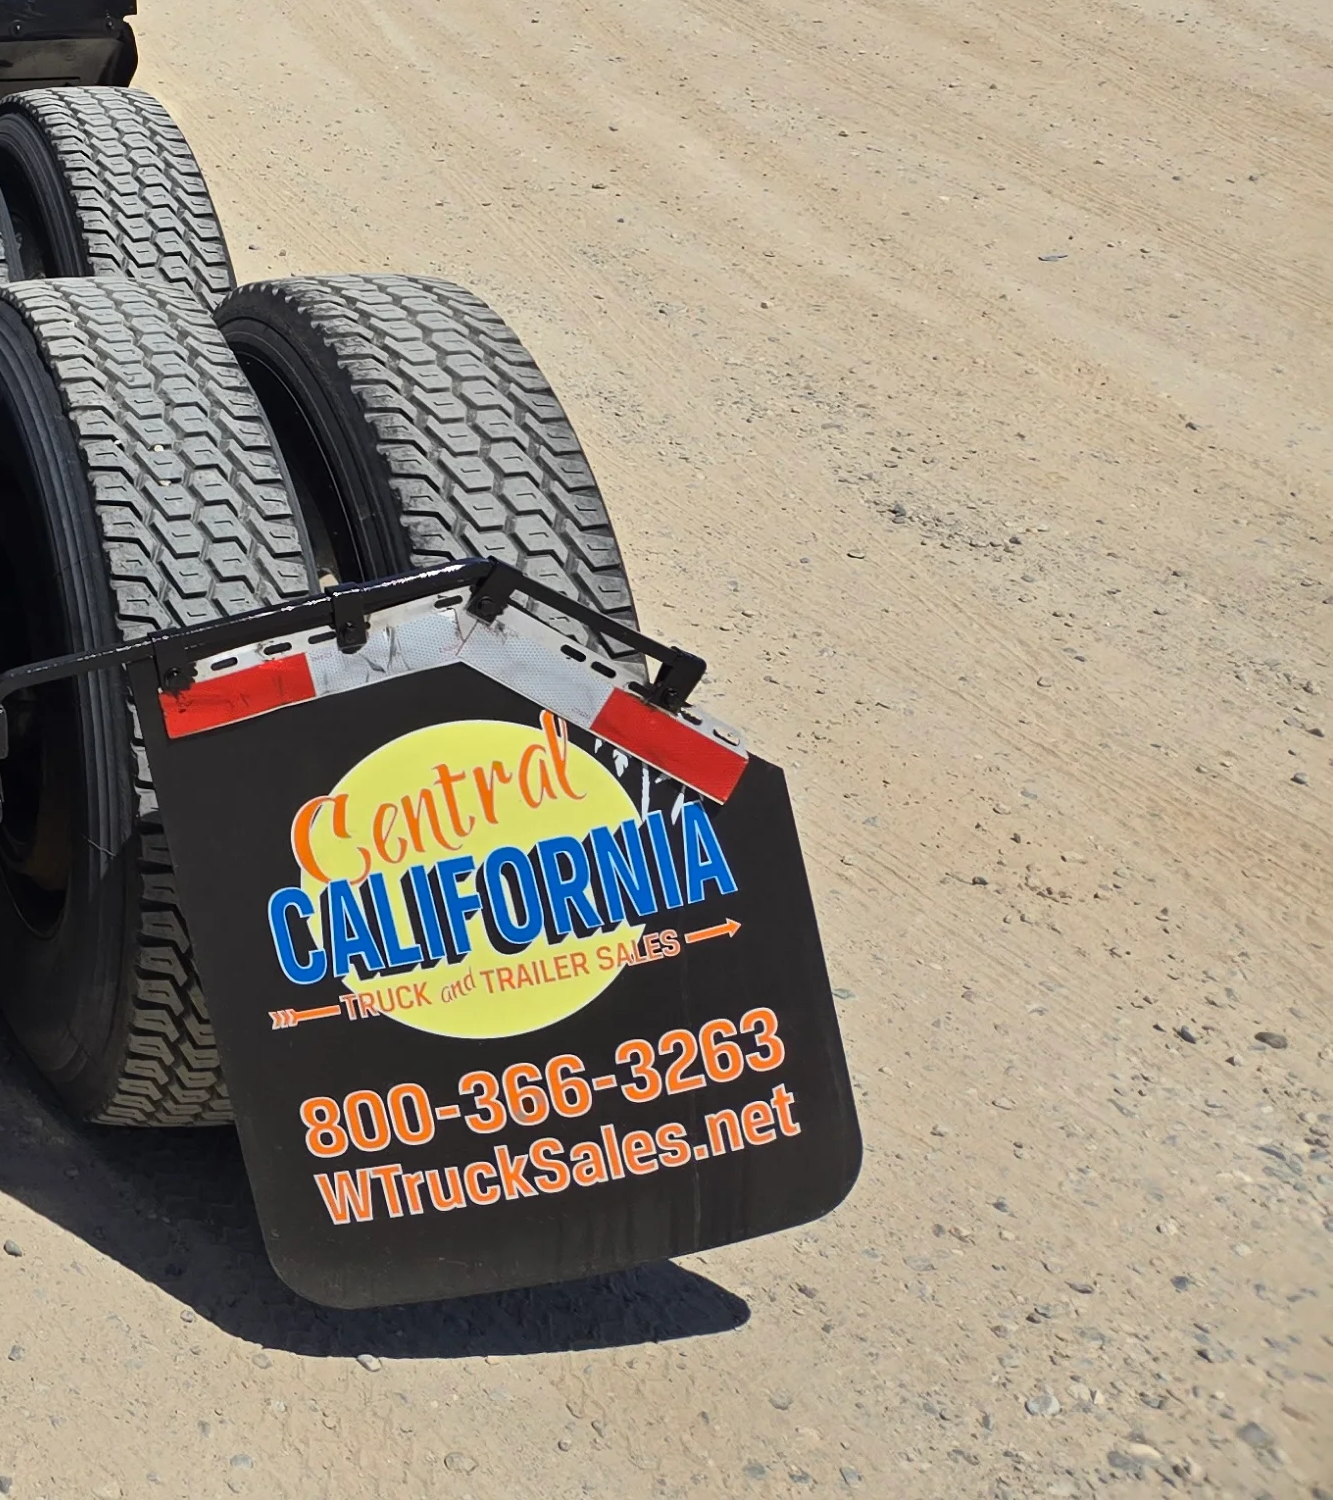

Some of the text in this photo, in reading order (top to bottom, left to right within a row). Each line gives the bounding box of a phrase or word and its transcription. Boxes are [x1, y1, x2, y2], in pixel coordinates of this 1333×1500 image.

[291, 710, 587, 886] Central
[268, 800, 737, 985] CALIFORNIA
[339, 929, 682, 1021] TRUCK and TRAILER SALES
[299, 1007, 786, 1159] 800-366-3263
[313, 1083, 802, 1225] WTruckSales.net
